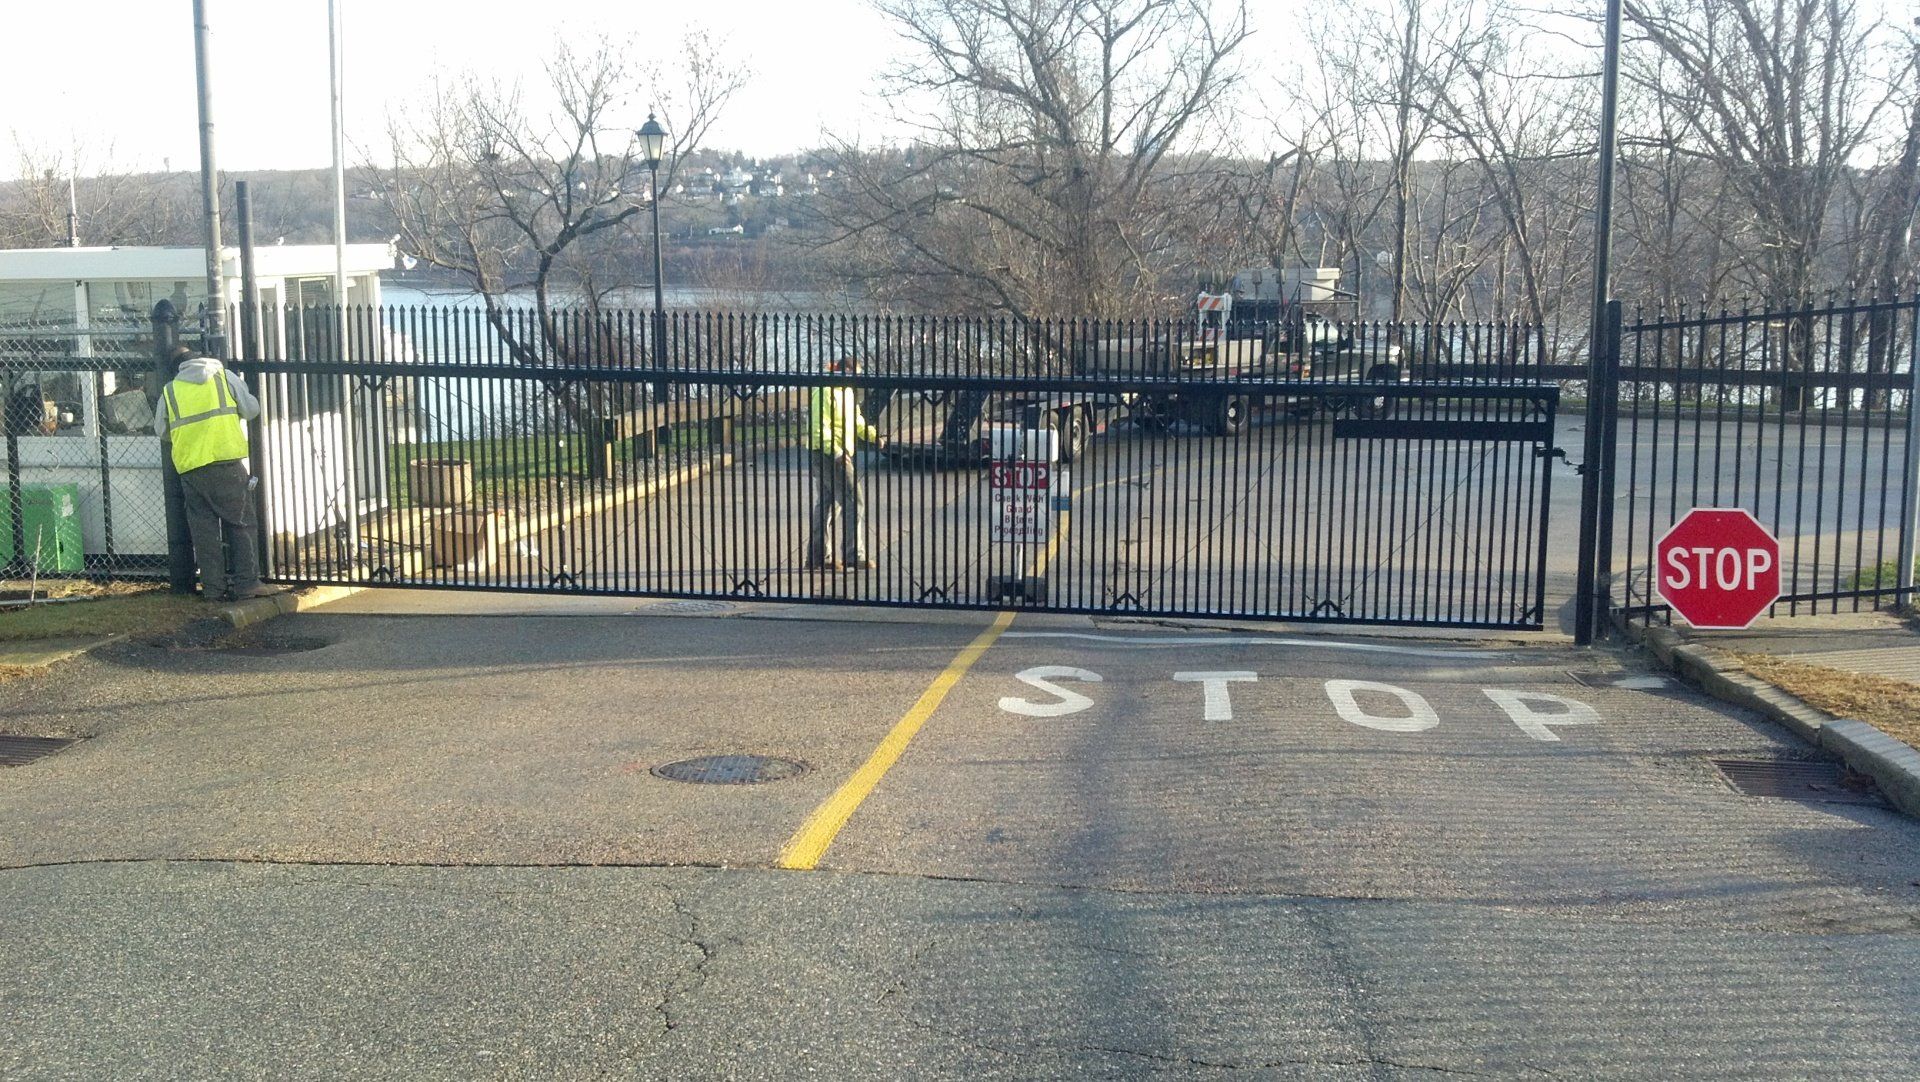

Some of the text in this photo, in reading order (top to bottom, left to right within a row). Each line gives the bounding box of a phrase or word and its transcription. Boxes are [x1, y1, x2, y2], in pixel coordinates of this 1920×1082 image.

[1005, 514, 1033, 524] Bfoe
[1665, 546, 1772, 591] STOP
[998, 665, 1601, 742] STOP
